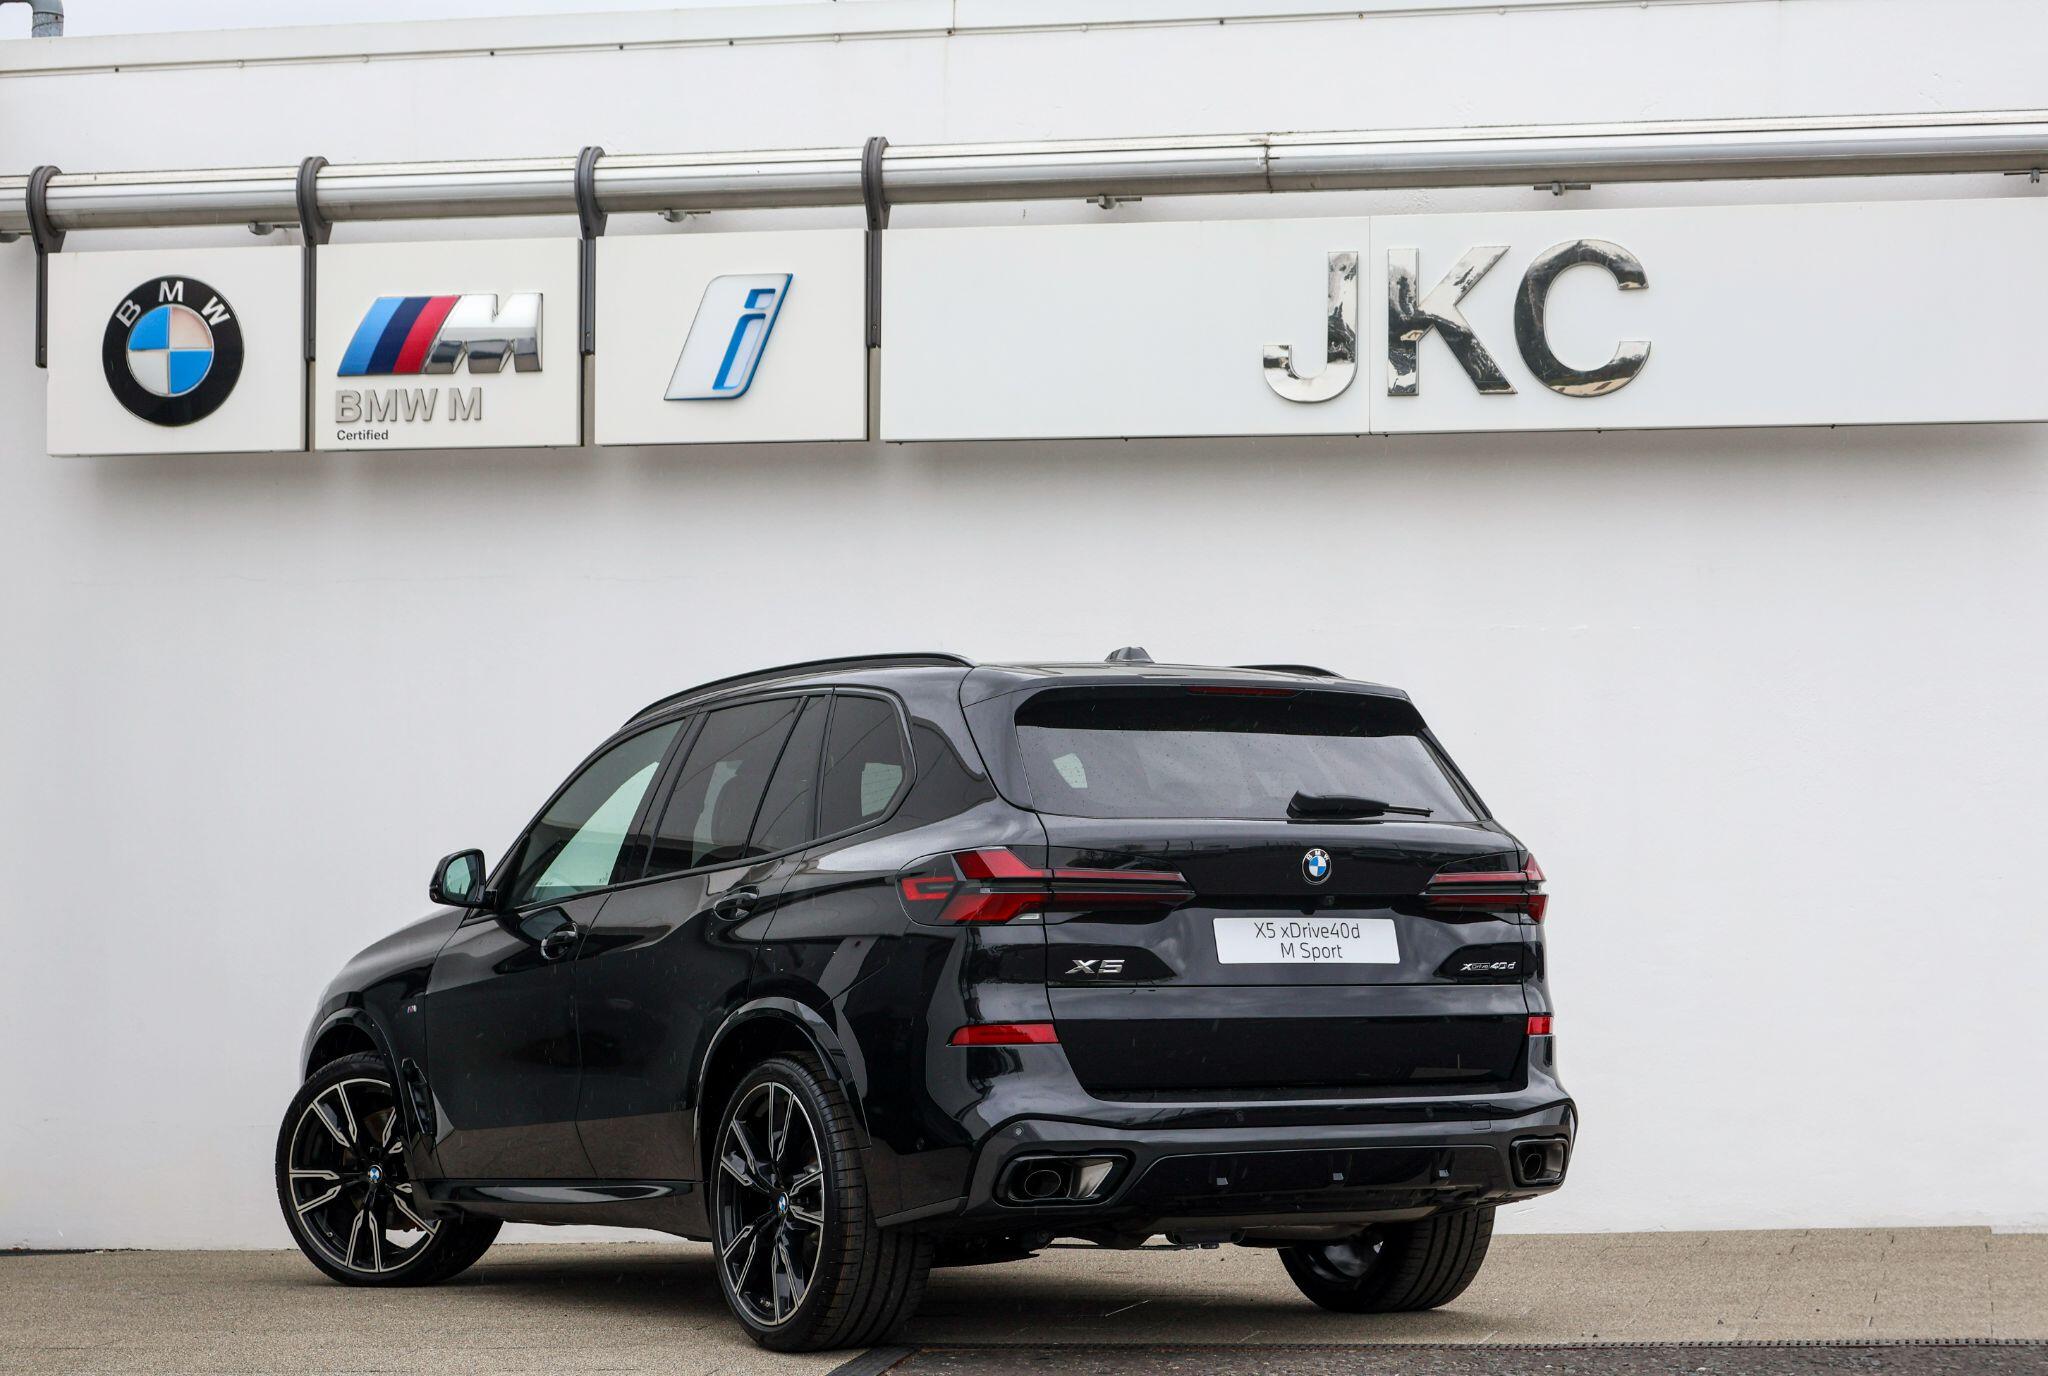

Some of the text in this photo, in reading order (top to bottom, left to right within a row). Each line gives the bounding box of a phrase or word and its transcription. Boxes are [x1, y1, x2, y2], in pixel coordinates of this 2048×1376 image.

[115, 280, 231, 328] BMW
[1263, 239, 1652, 403] JKC
[335, 387, 482, 423] BMW M
[336, 429, 389, 441] Certified
[1254, 922, 1361, 939] X5 xDrive40d
[1280, 942, 1343, 962] M Sport
[1065, 959, 1126, 975] X5
